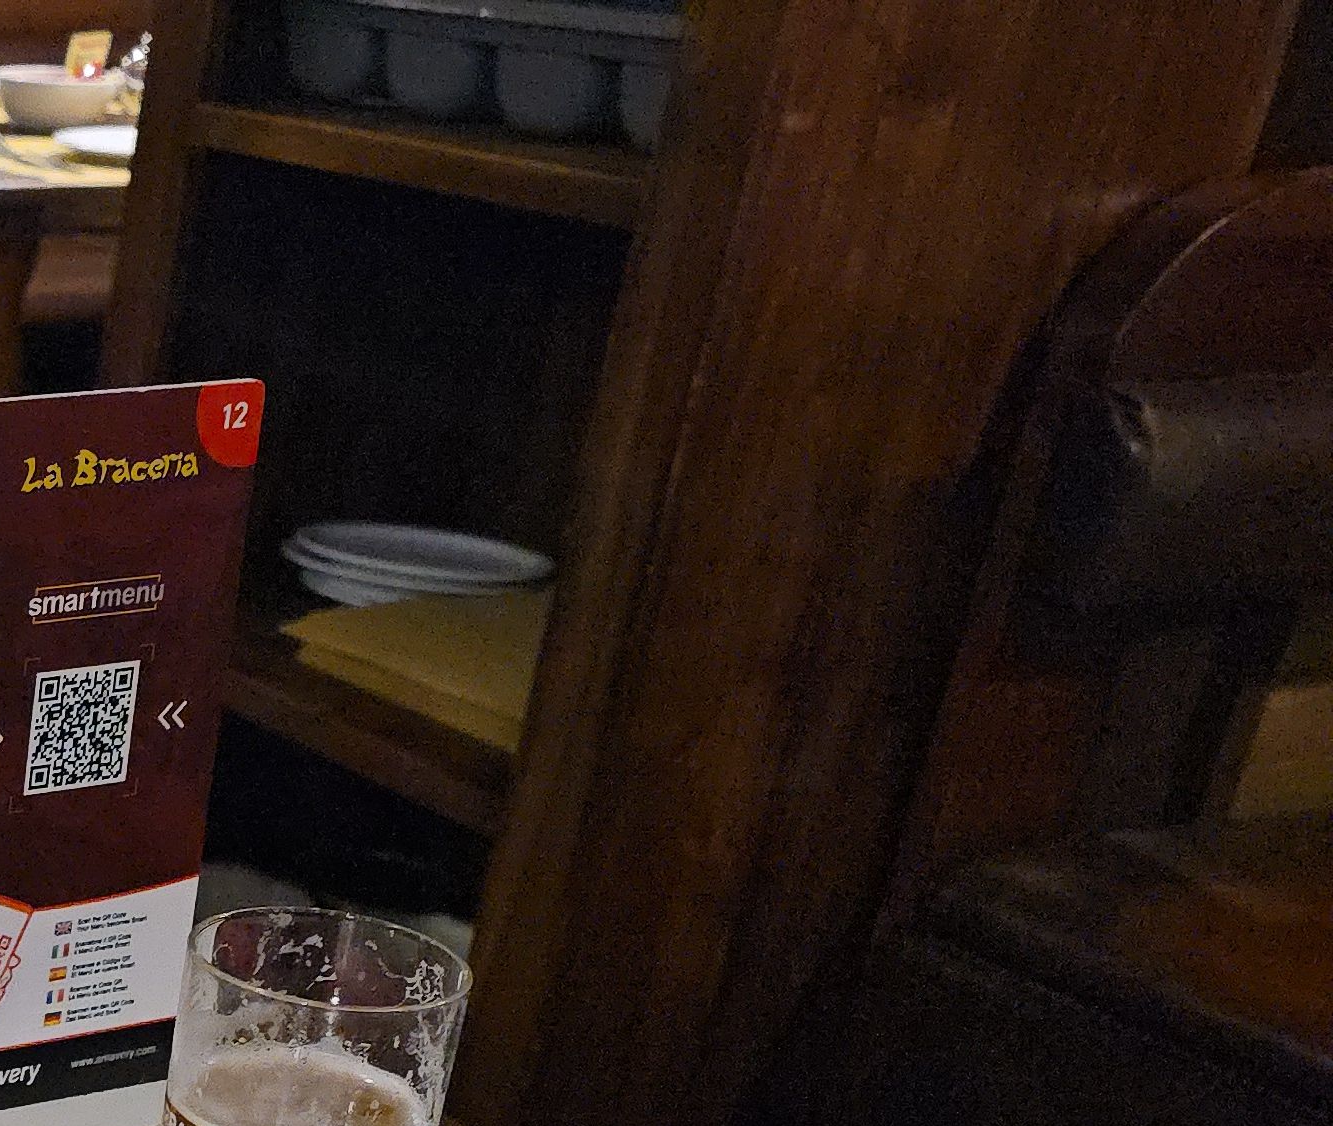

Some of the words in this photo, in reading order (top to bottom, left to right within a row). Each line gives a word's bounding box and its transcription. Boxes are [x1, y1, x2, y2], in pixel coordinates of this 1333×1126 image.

[222, 400, 249, 430] 12
[20, 456, 63, 493] La
[71, 449, 200, 487] Braceria
